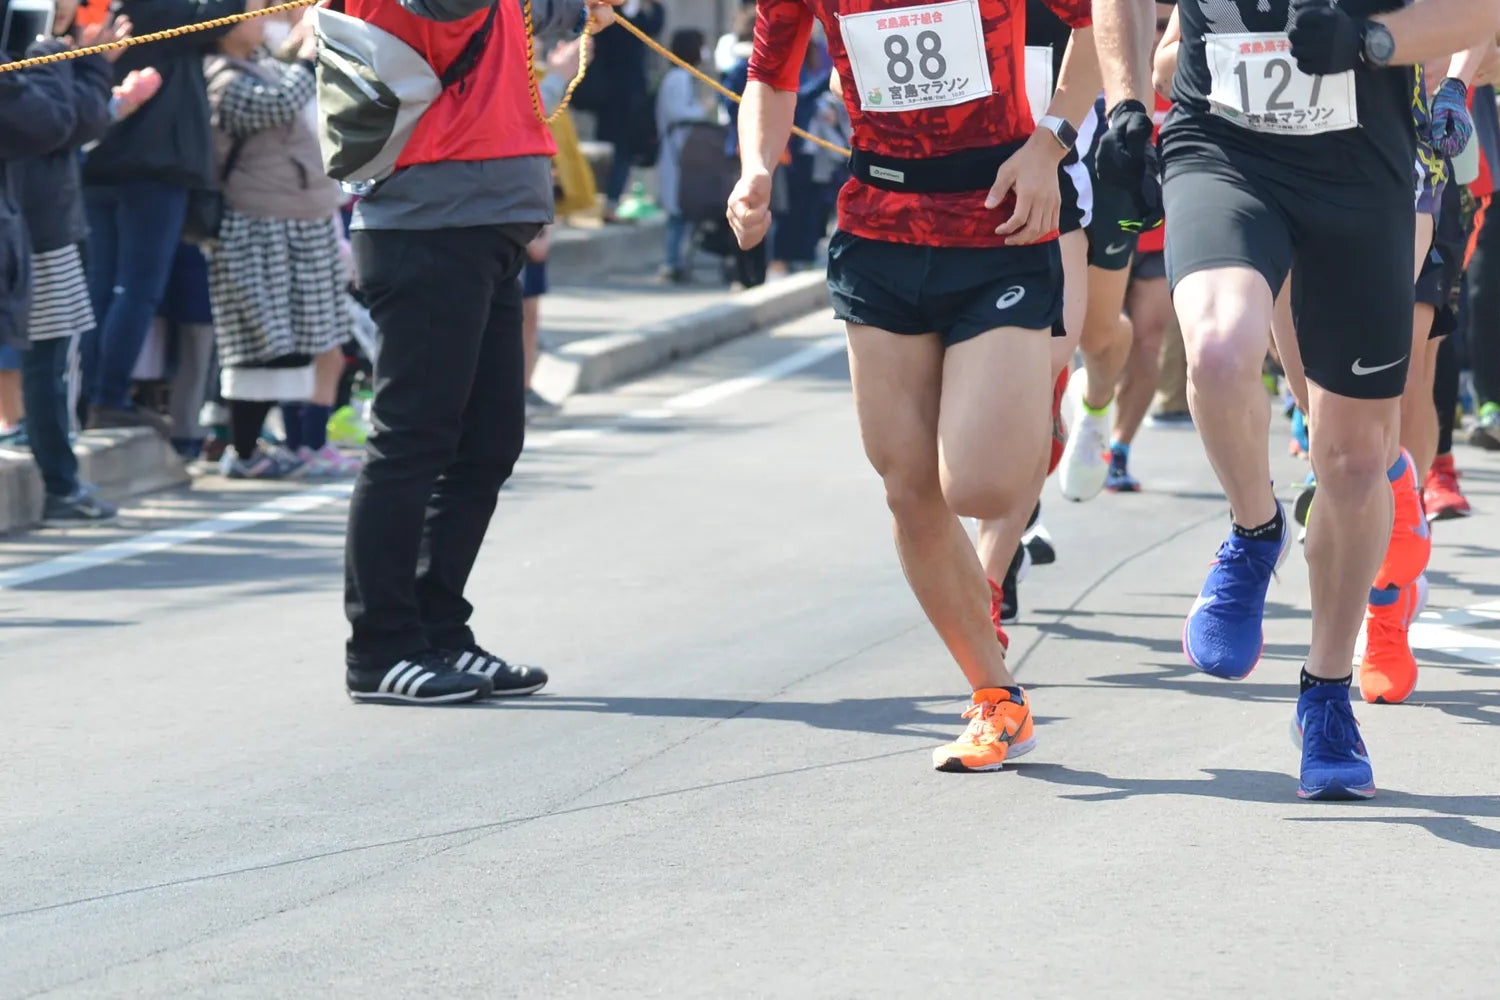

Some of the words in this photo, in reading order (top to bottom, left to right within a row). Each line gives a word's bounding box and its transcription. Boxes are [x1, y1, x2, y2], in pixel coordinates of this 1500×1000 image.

[884, 30, 947, 85] 88
[888, 77, 969, 100] 宮島マラソン
